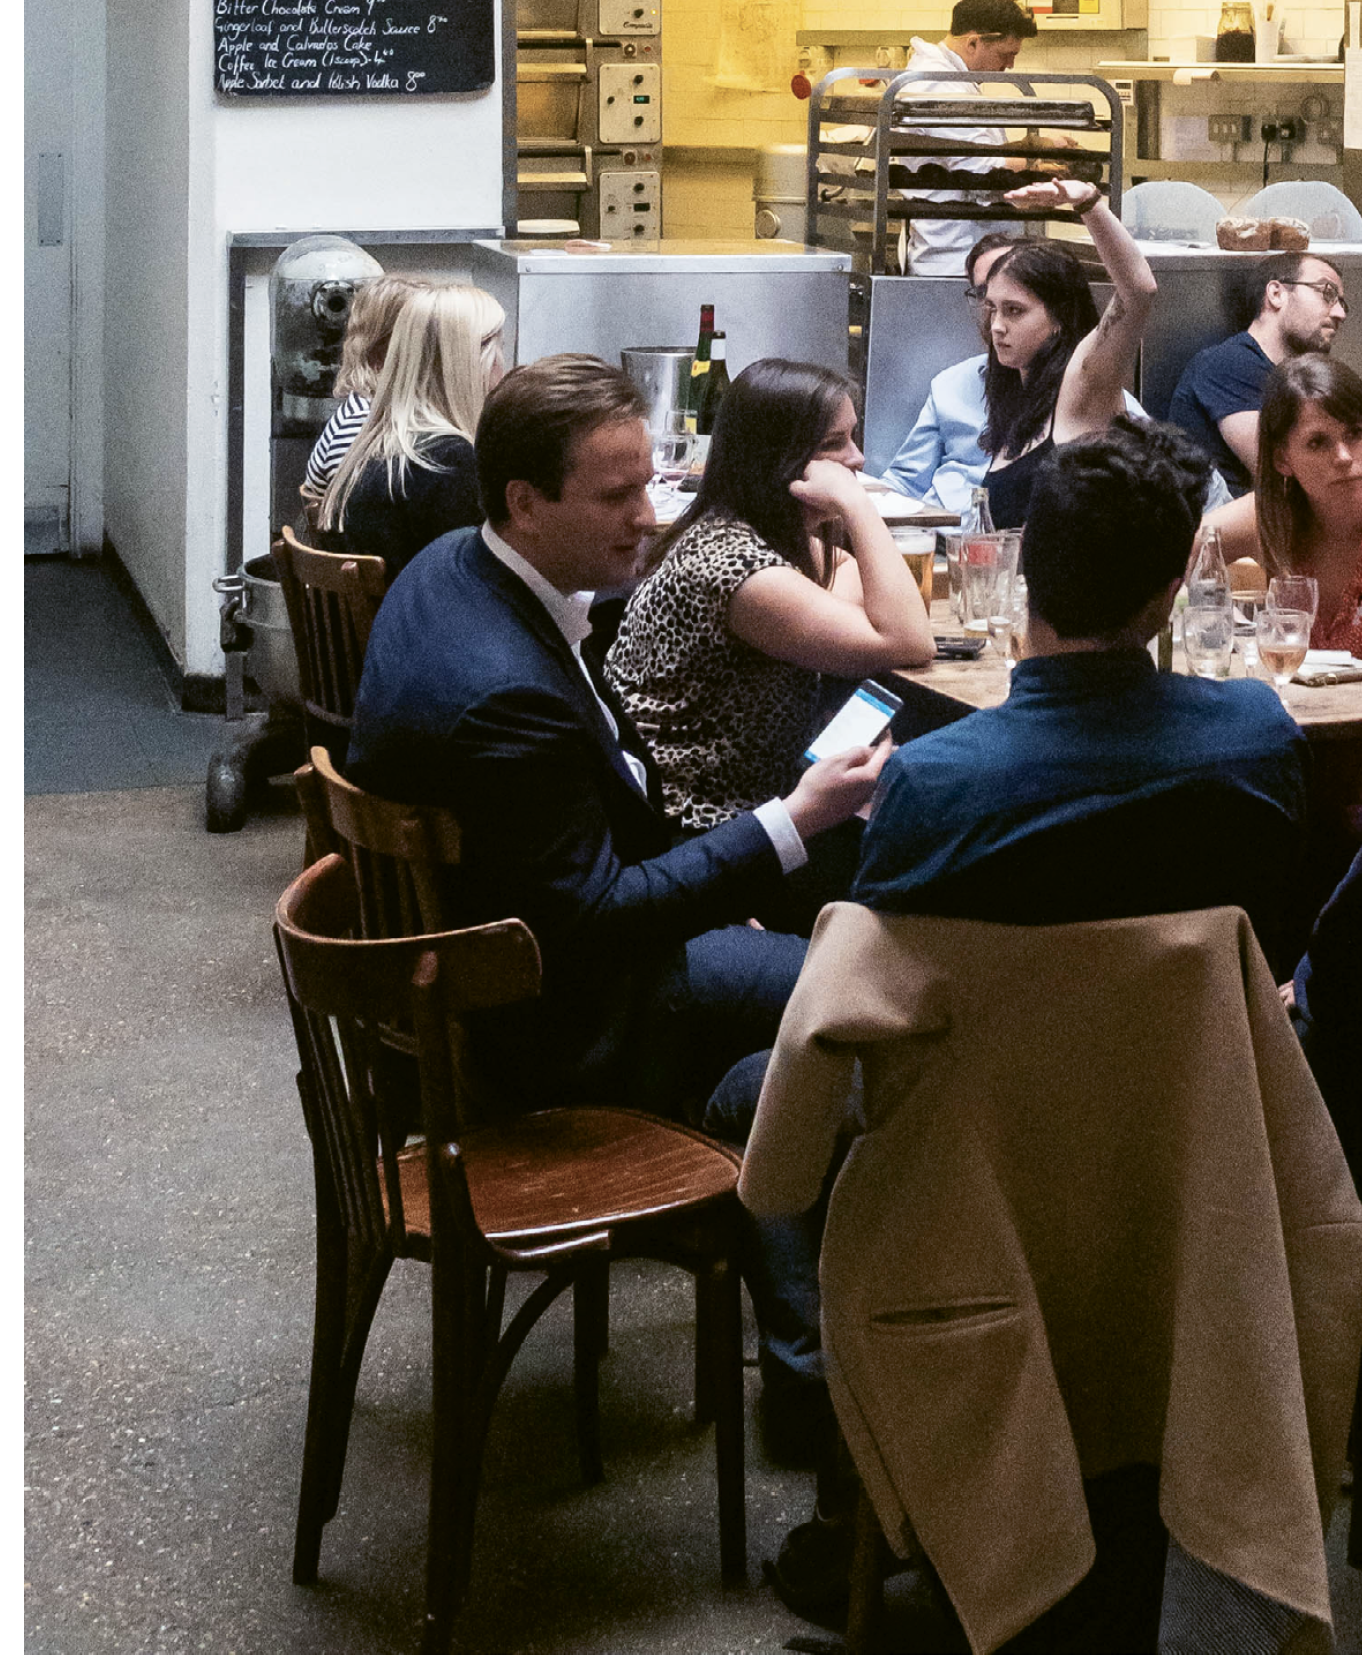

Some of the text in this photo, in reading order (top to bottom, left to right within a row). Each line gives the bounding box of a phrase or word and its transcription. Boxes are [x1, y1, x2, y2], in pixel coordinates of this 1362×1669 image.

[280, 17, 303, 32] and
[309, 16, 377, 35] Butterscotch
[382, 17, 421, 35] Sauce
[218, 34, 373, 55] Apple and Calvados Cake
[218, 51, 317, 75] Coffee Ice Cream
[217, 71, 399, 92] Apple Sorbet and Polish Vodka
